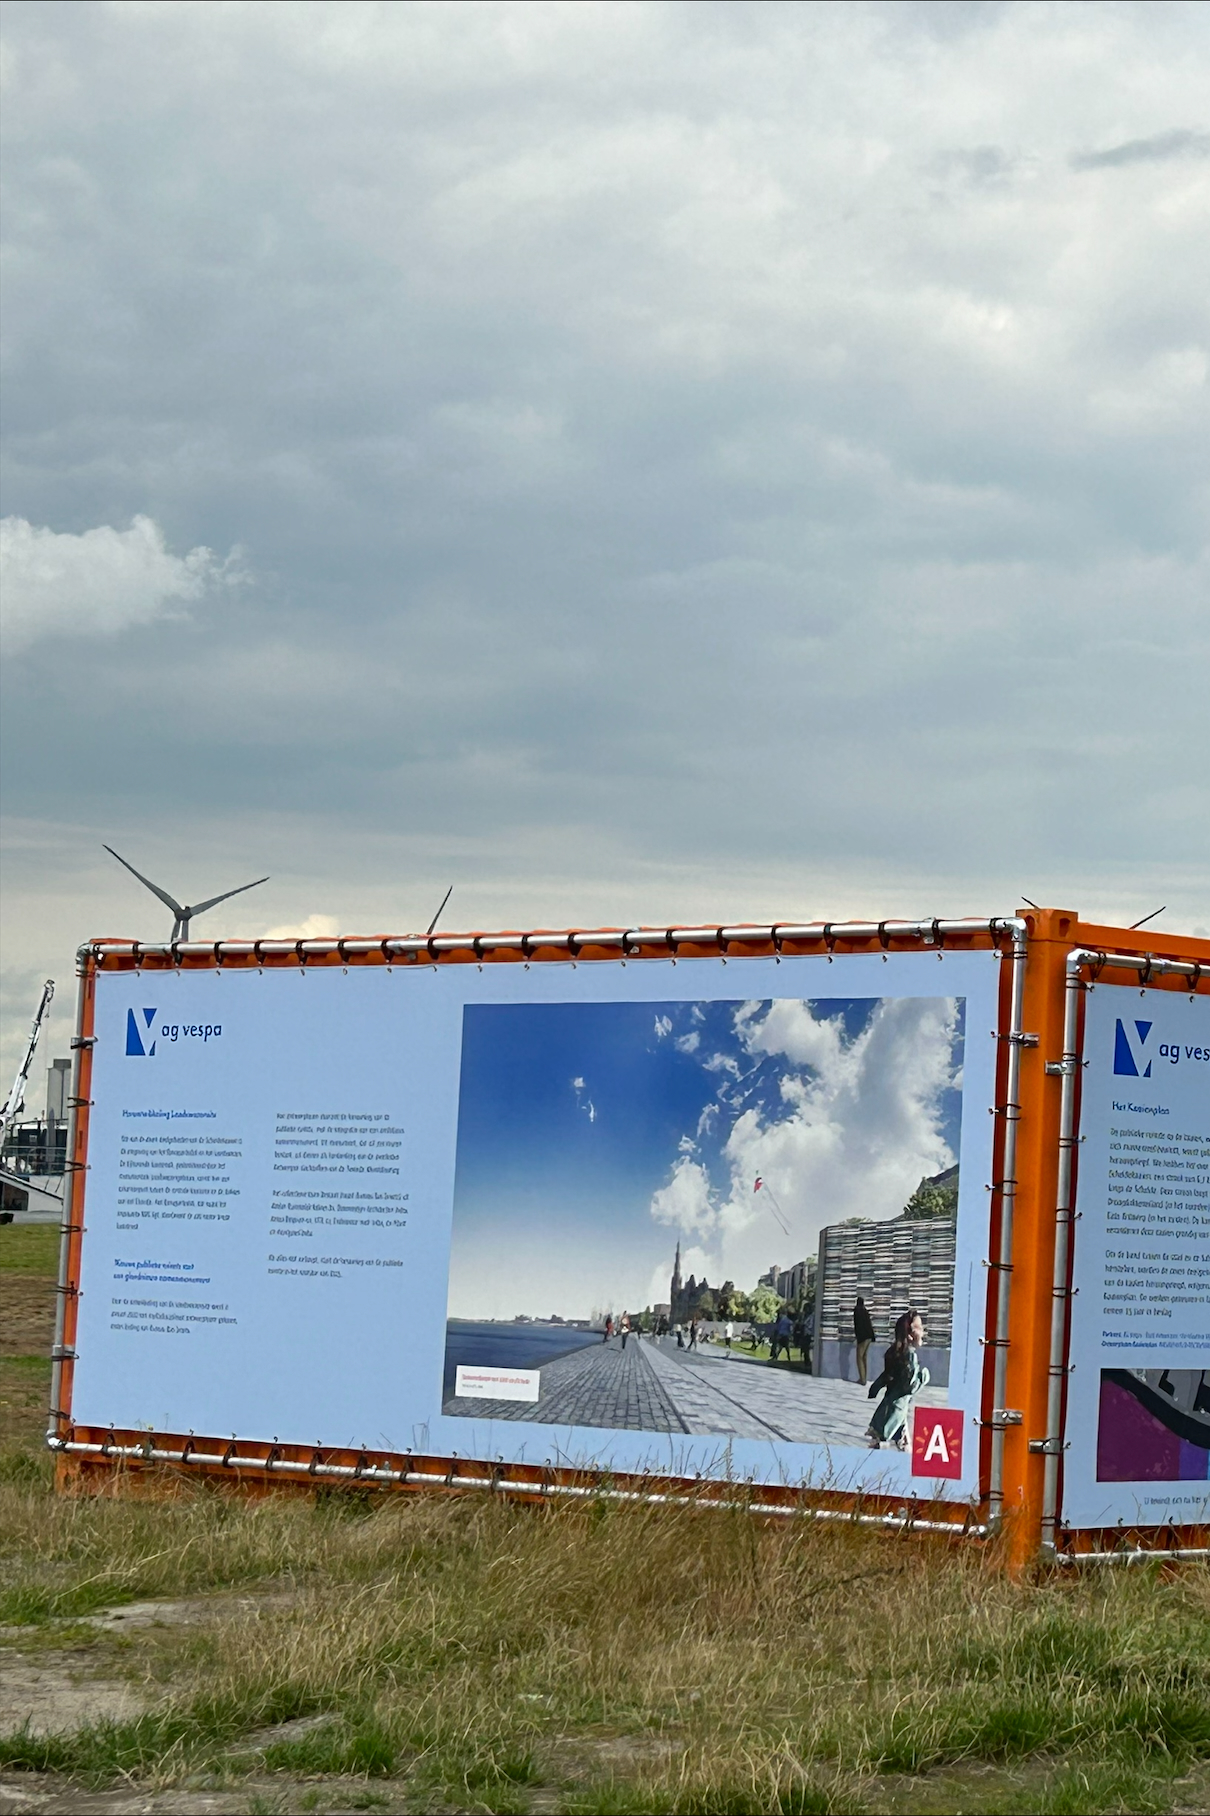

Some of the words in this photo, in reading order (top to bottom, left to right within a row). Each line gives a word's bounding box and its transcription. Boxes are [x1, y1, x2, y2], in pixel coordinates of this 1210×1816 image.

[162, 1025, 179, 1042] ag
[182, 1025, 222, 1043] vespa
[1159, 1044, 1180, 1064] ag
[924, 1424, 949, 1462] A
